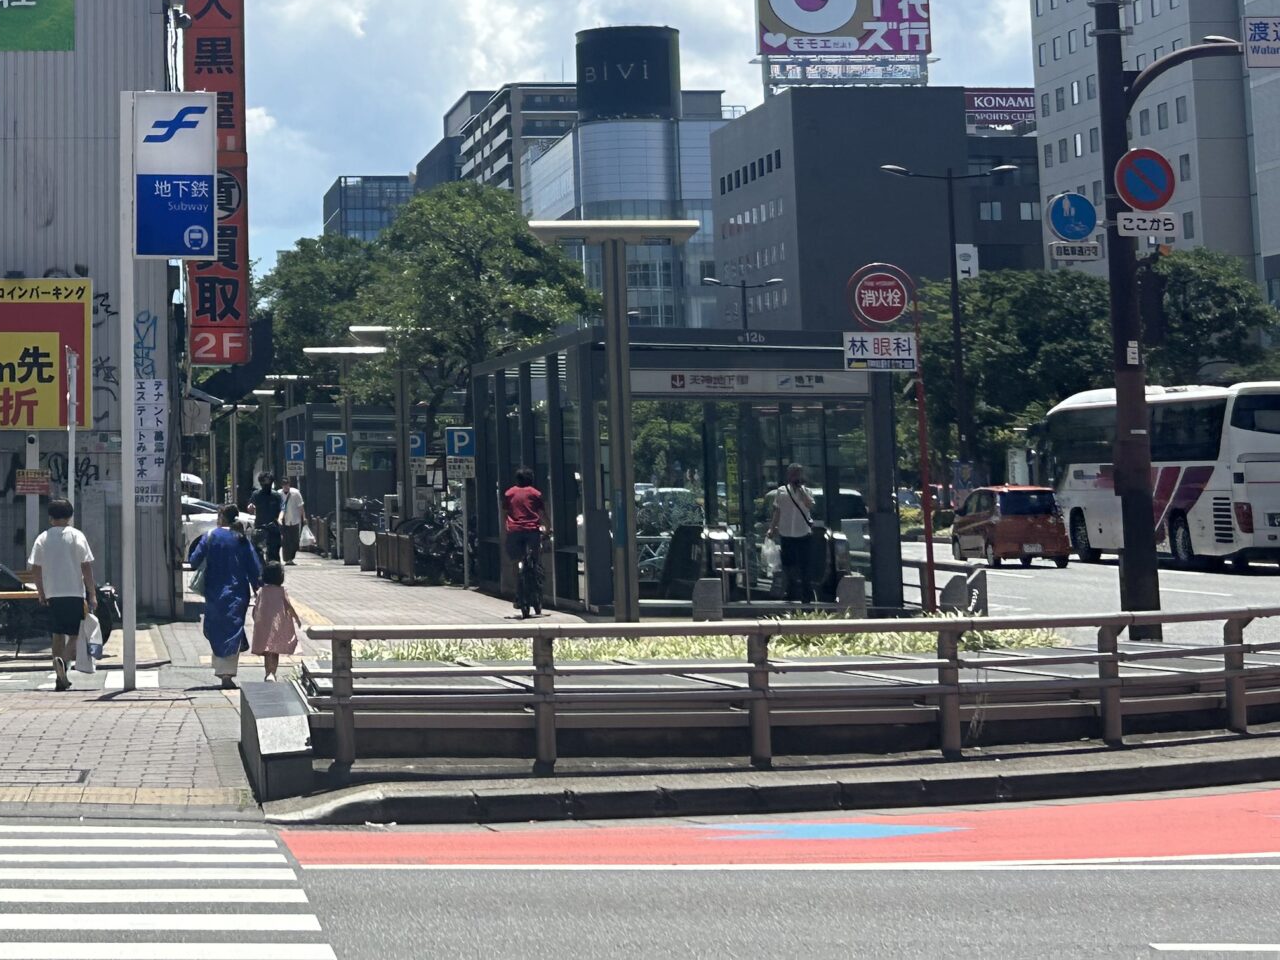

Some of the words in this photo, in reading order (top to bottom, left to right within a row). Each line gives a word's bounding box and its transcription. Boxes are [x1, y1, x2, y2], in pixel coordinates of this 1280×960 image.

[974, 96, 1034, 108] KONAMI
[154, 180, 209, 198] 地下鉄
[168, 201, 209, 213] Subway
[1123, 217, 1176, 232] ここから
[860, 289, 902, 307] 消火栓
[193, 332, 245, 359] 2F
[848, 337, 912, 357] 林眼科
[290, 443, 301, 459] P
[332, 436, 343, 453] P
[451, 431, 469, 454] P
